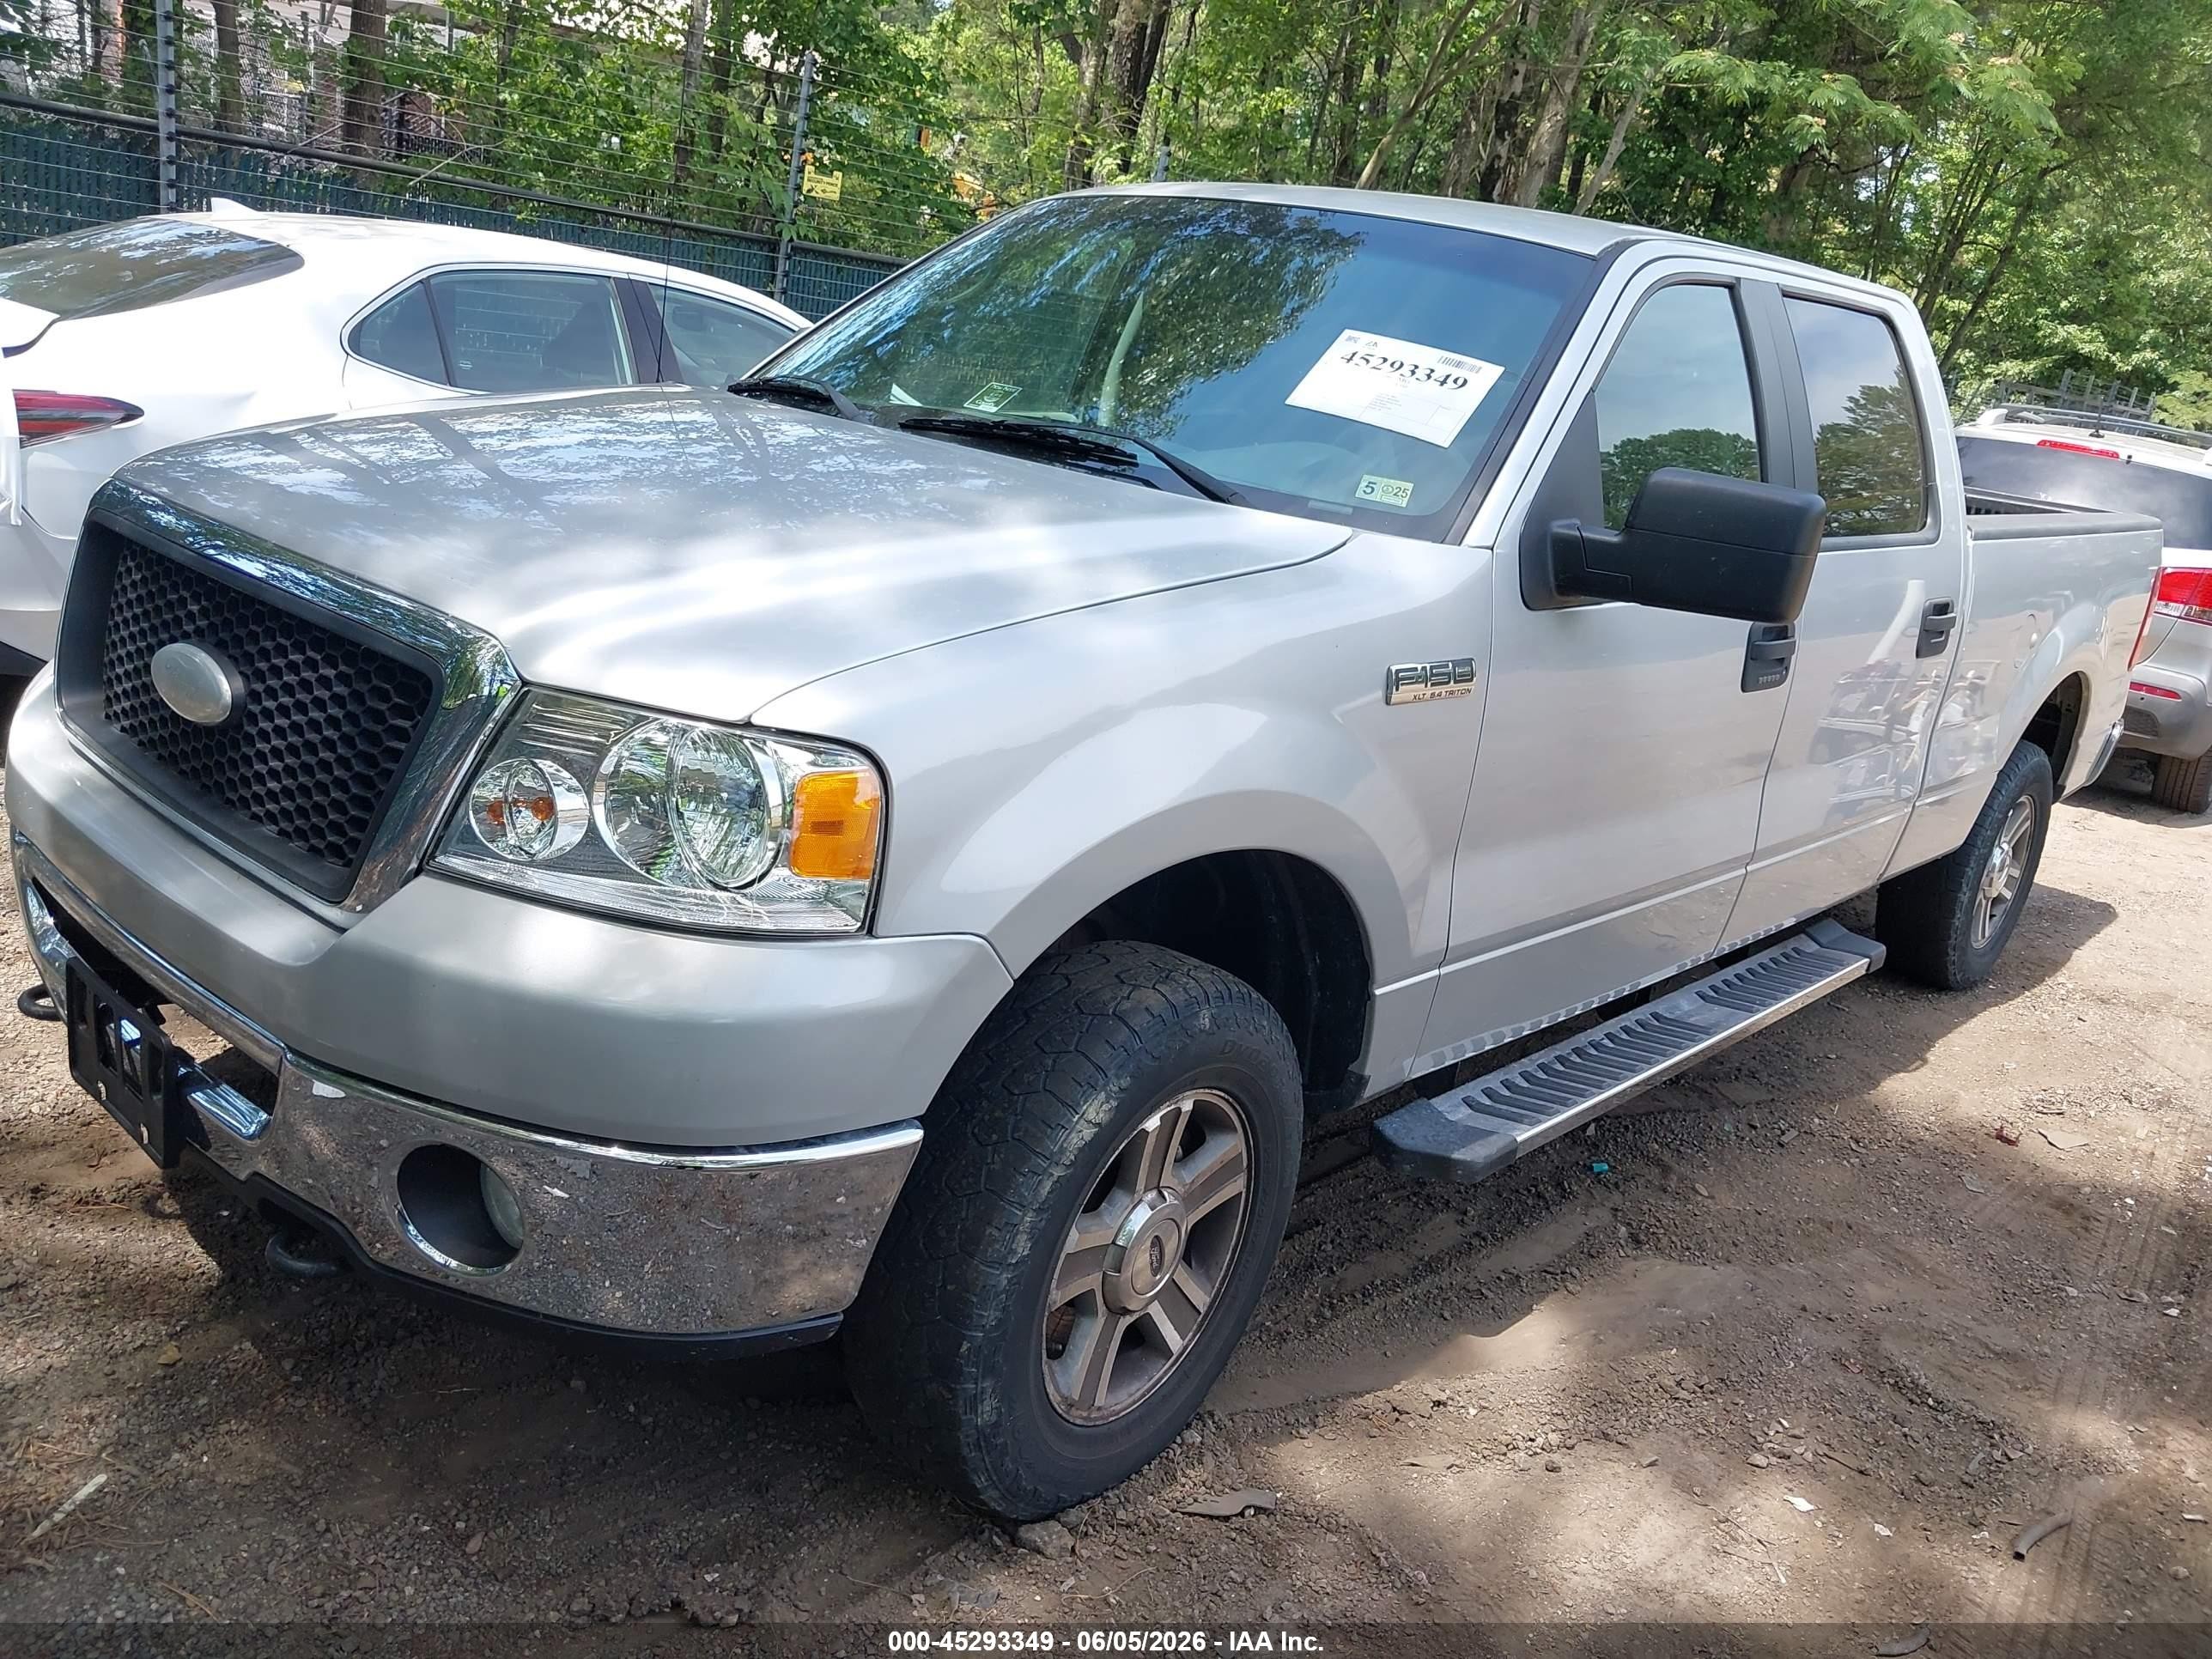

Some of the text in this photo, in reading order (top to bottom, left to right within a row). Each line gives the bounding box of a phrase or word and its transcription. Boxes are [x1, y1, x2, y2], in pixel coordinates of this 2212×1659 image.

[1340, 350, 1468, 391] 45293349
[1362, 481, 1409, 499] 5 25
[1412, 692, 1426, 702] XLT
[1443, 687, 1473, 697] TRITON
